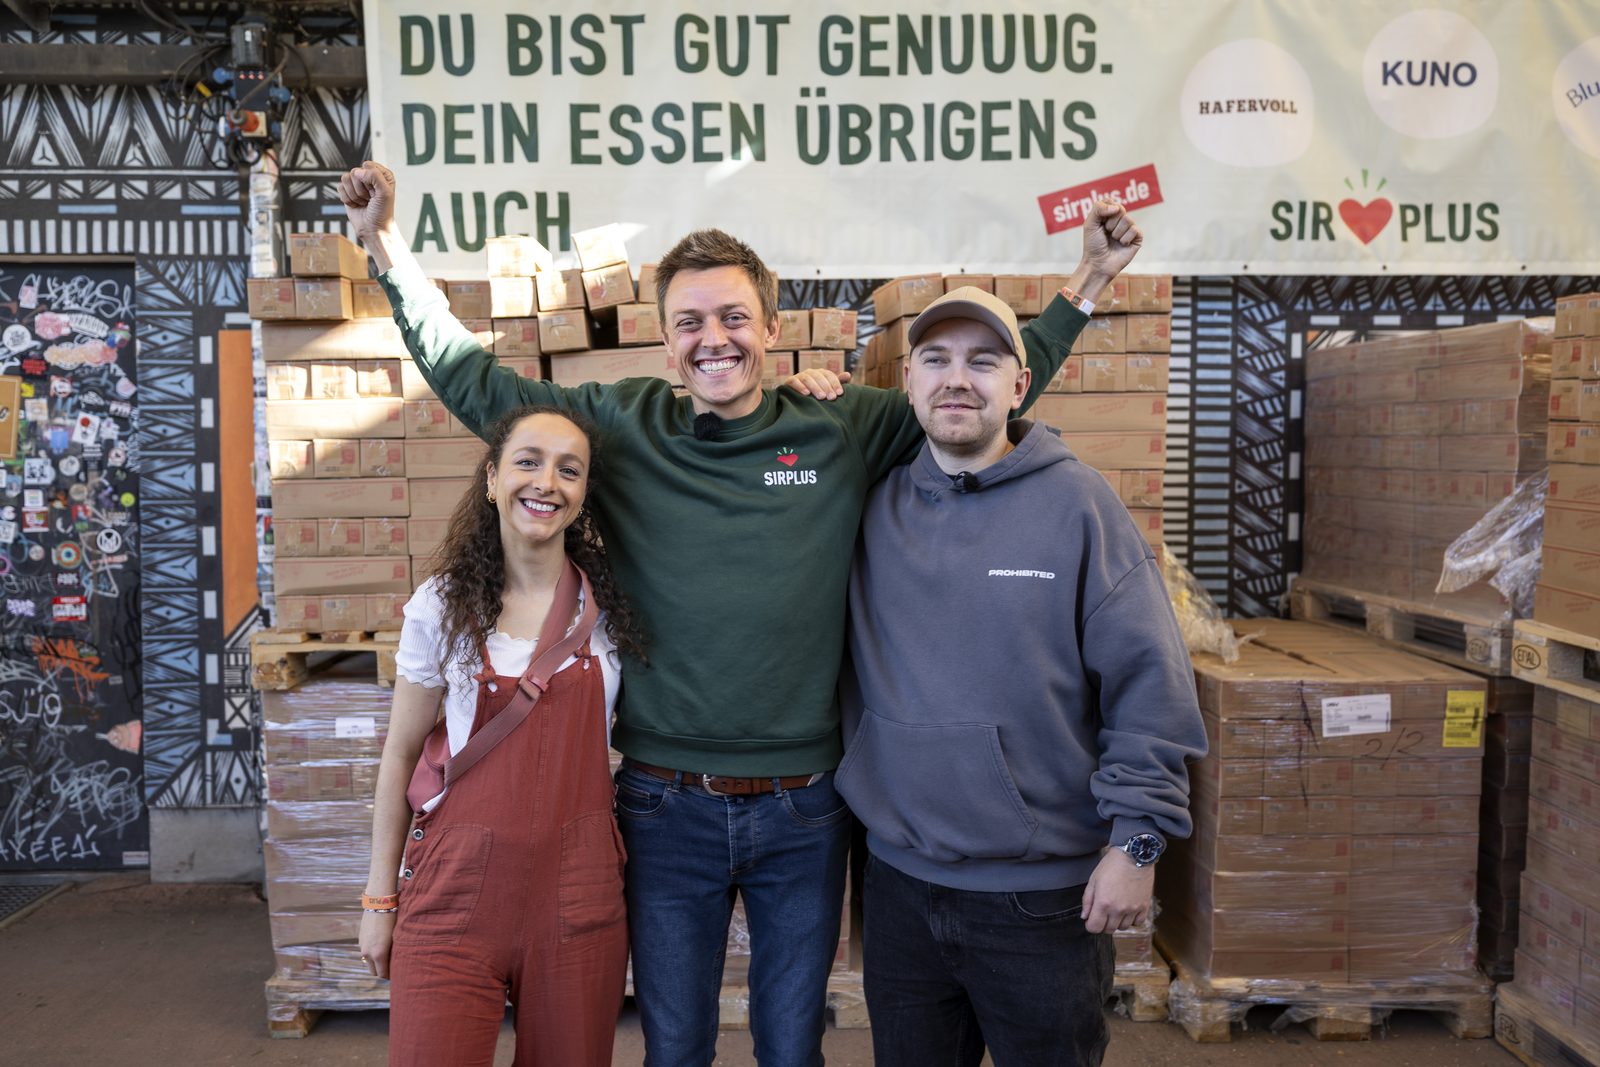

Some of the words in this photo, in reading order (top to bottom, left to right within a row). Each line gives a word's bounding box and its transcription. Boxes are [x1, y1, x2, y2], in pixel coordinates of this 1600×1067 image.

[399, 14, 475, 76] DU
[506, 13, 645, 76] BIST
[675, 13, 791, 76] GUT
[818, 13, 1113, 76] GENUUUG.
[1382, 60, 1478, 88] KUNO
[402, 101, 539, 166] DEIN
[569, 101, 766, 166] ESSEN
[796, 87, 1097, 166] ÜBRIGENS
[1199, 98, 1298, 115] HAFERVOLL
[412, 191, 570, 253] AUCH
[1270, 200, 1336, 242] SIR
[1399, 201, 1500, 243] PLUS
[763, 469, 818, 486] SIRPLUS
[988, 569, 1056, 580] PROHIBITED
[1361, 727, 1425, 770] 2/2
